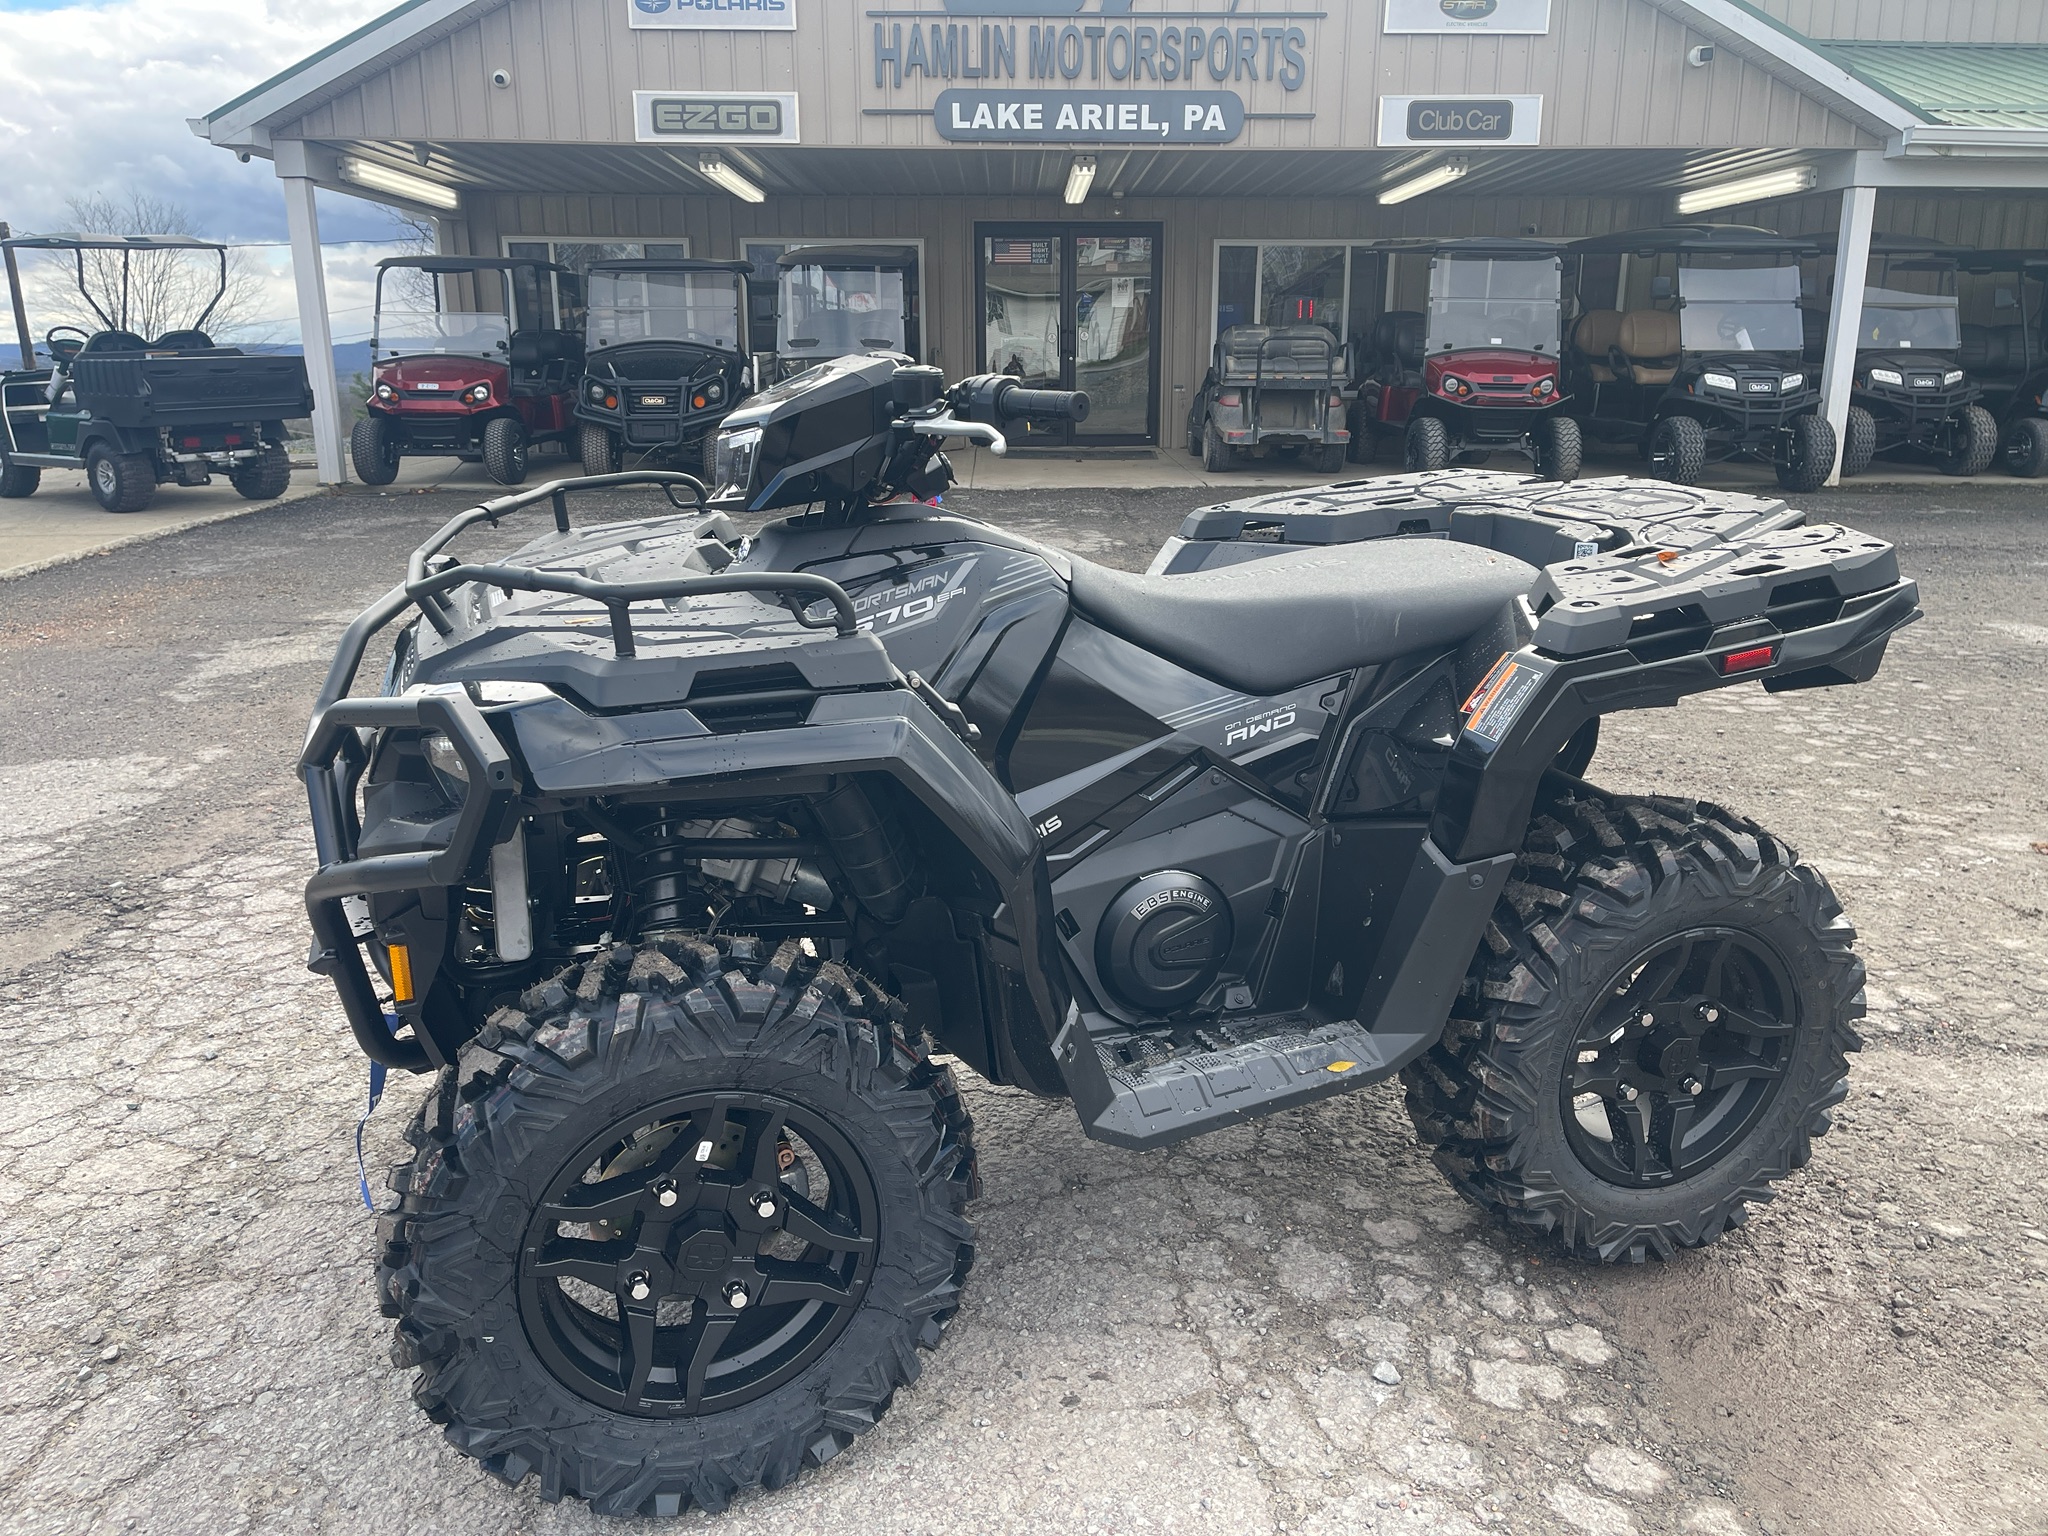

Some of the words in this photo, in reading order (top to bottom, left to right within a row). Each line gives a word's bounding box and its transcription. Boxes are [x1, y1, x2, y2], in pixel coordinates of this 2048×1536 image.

[874, 22, 1016, 88] HAMLIN
[1029, 25, 1307, 91] MOTORSPORTS
[656, 104, 778, 130] EZGO
[951, 103, 1043, 130] LAKE
[1055, 103, 1170, 137] ARIEL,
[1184, 104, 1227, 131] PA
[1418, 109, 1464, 132] Club
[1465, 109, 1502, 132] Car
[1226, 711, 1296, 746] AWD
[1135, 891, 1169, 917] EBS
[1172, 890, 1210, 907] ENGINE
